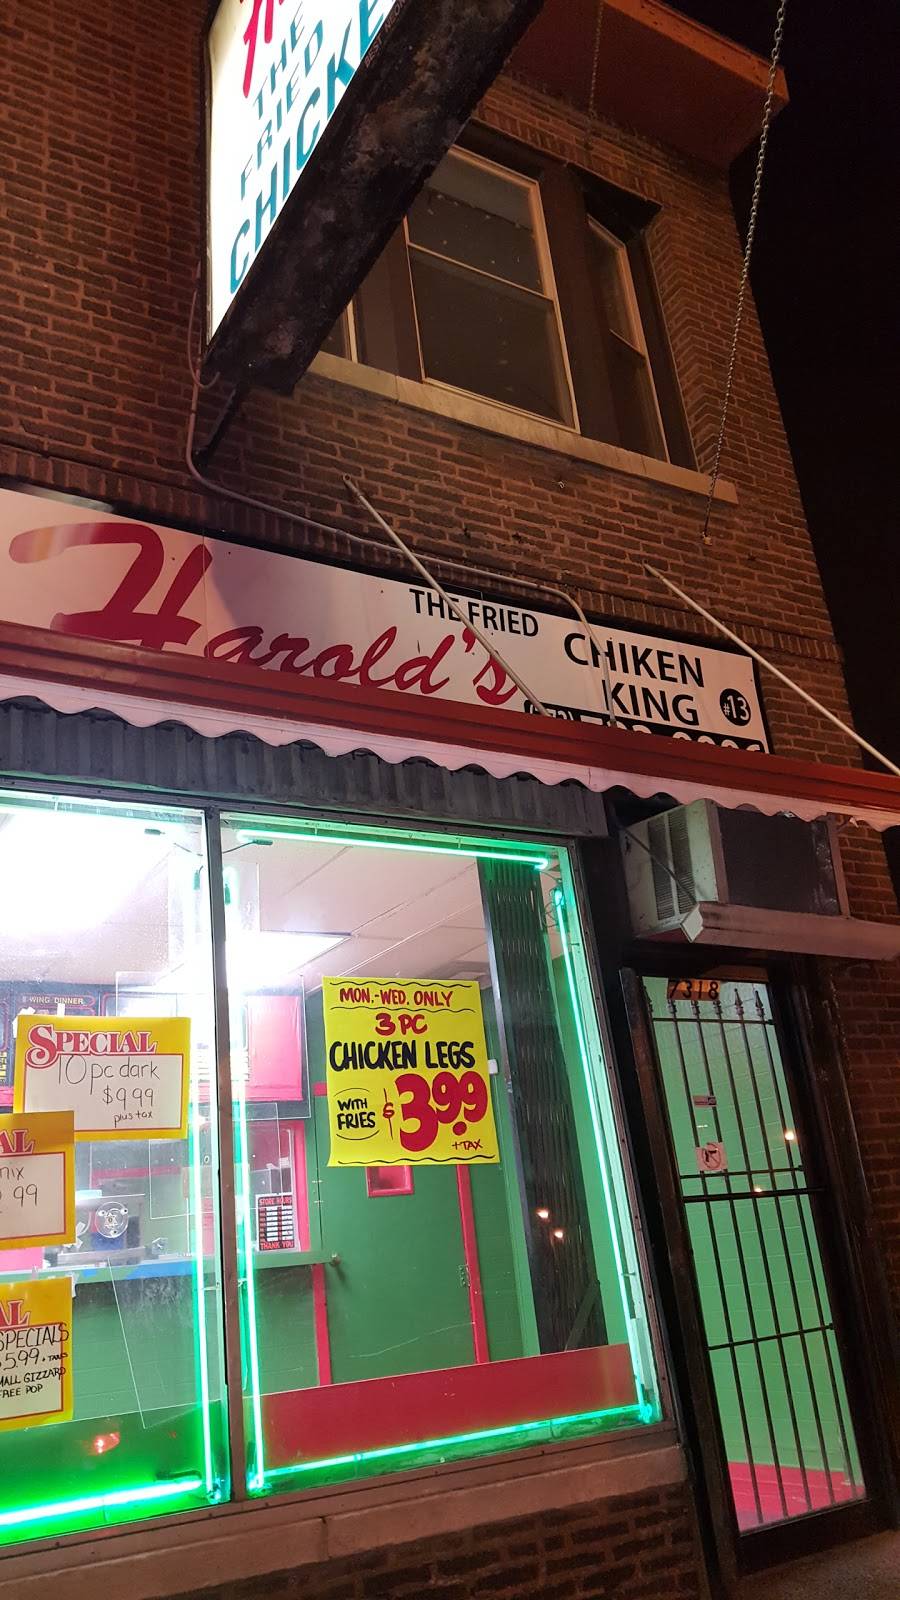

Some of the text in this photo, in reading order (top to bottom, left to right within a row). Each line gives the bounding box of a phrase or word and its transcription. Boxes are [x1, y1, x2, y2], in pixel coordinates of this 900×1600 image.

[253, 2, 305, 121] THE
[240, 19, 324, 202] FRIED
[8, 522, 518, 706] Harold's
[409, 588, 539, 637] THE FRIED
[563, 632, 705, 688] CHIKEN
[601, 679, 751, 726] KING #13
[30, 996, 50, 1004] WING
[54, 996, 85, 1005] DINNER
[413, 990, 454, 1008] ONLY
[374, 1012, 428, 1037] 3 PC
[25, 1024, 158, 1069] SPECIAL
[329, 1040, 476, 1072] CHICKEN LEGS
[119, 1056, 161, 1081] dark
[337, 1098, 368, 1112] WITH
[114, 1112, 134, 1129] plus
[336, 1112, 376, 1130] FRIES
[276, 1196, 293, 1205] HORS
[0, 1383, 44, 1399] REE POP
